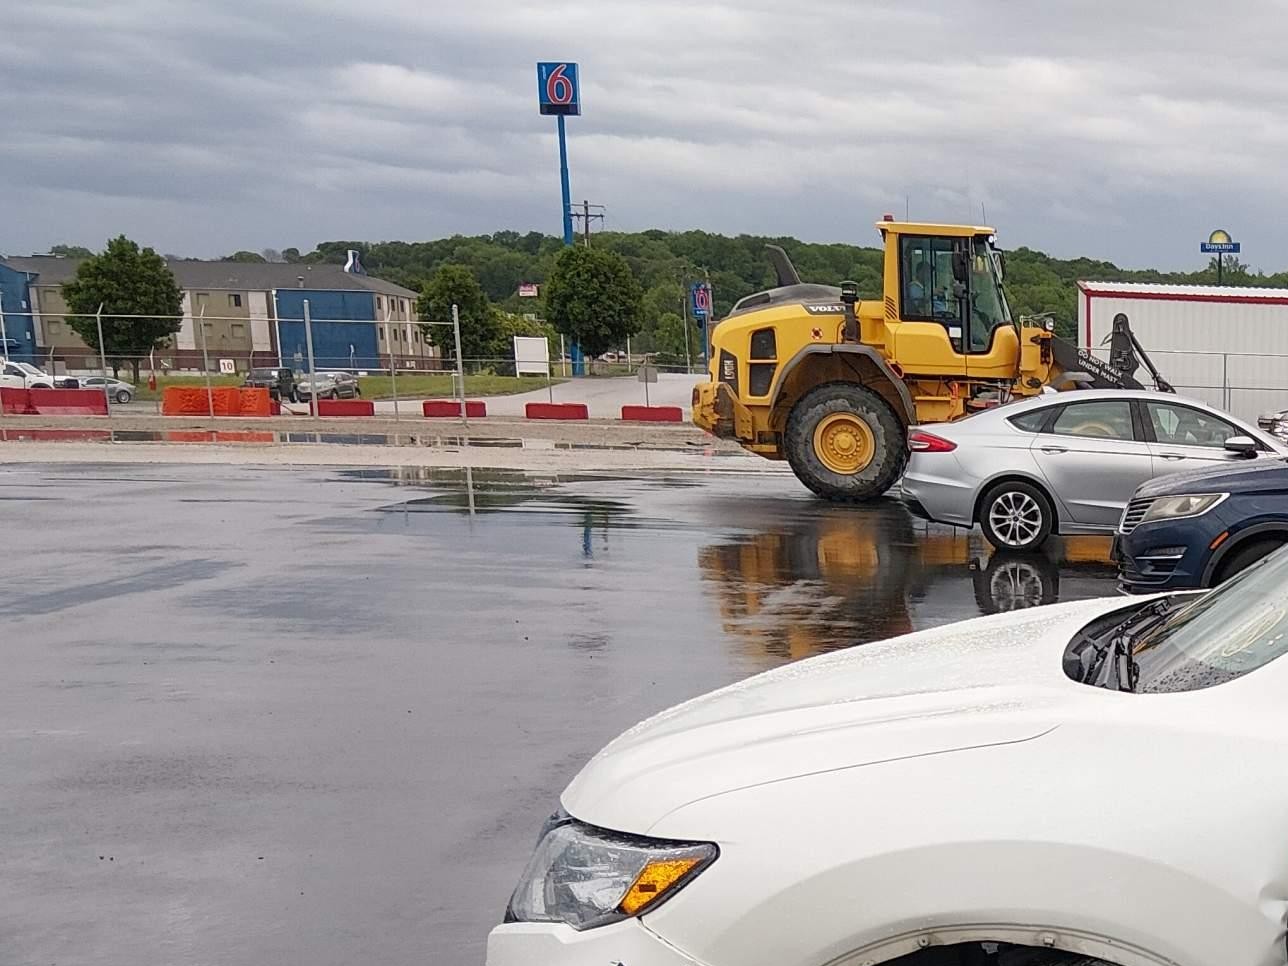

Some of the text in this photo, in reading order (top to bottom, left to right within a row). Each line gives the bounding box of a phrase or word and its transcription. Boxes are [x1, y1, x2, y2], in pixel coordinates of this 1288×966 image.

[547, 64, 573, 104] 6
[222, 362, 233, 371] 10
[1078, 350, 1123, 379] DO NOT WALK
[1078, 359, 1118, 384] UNDER MAST
